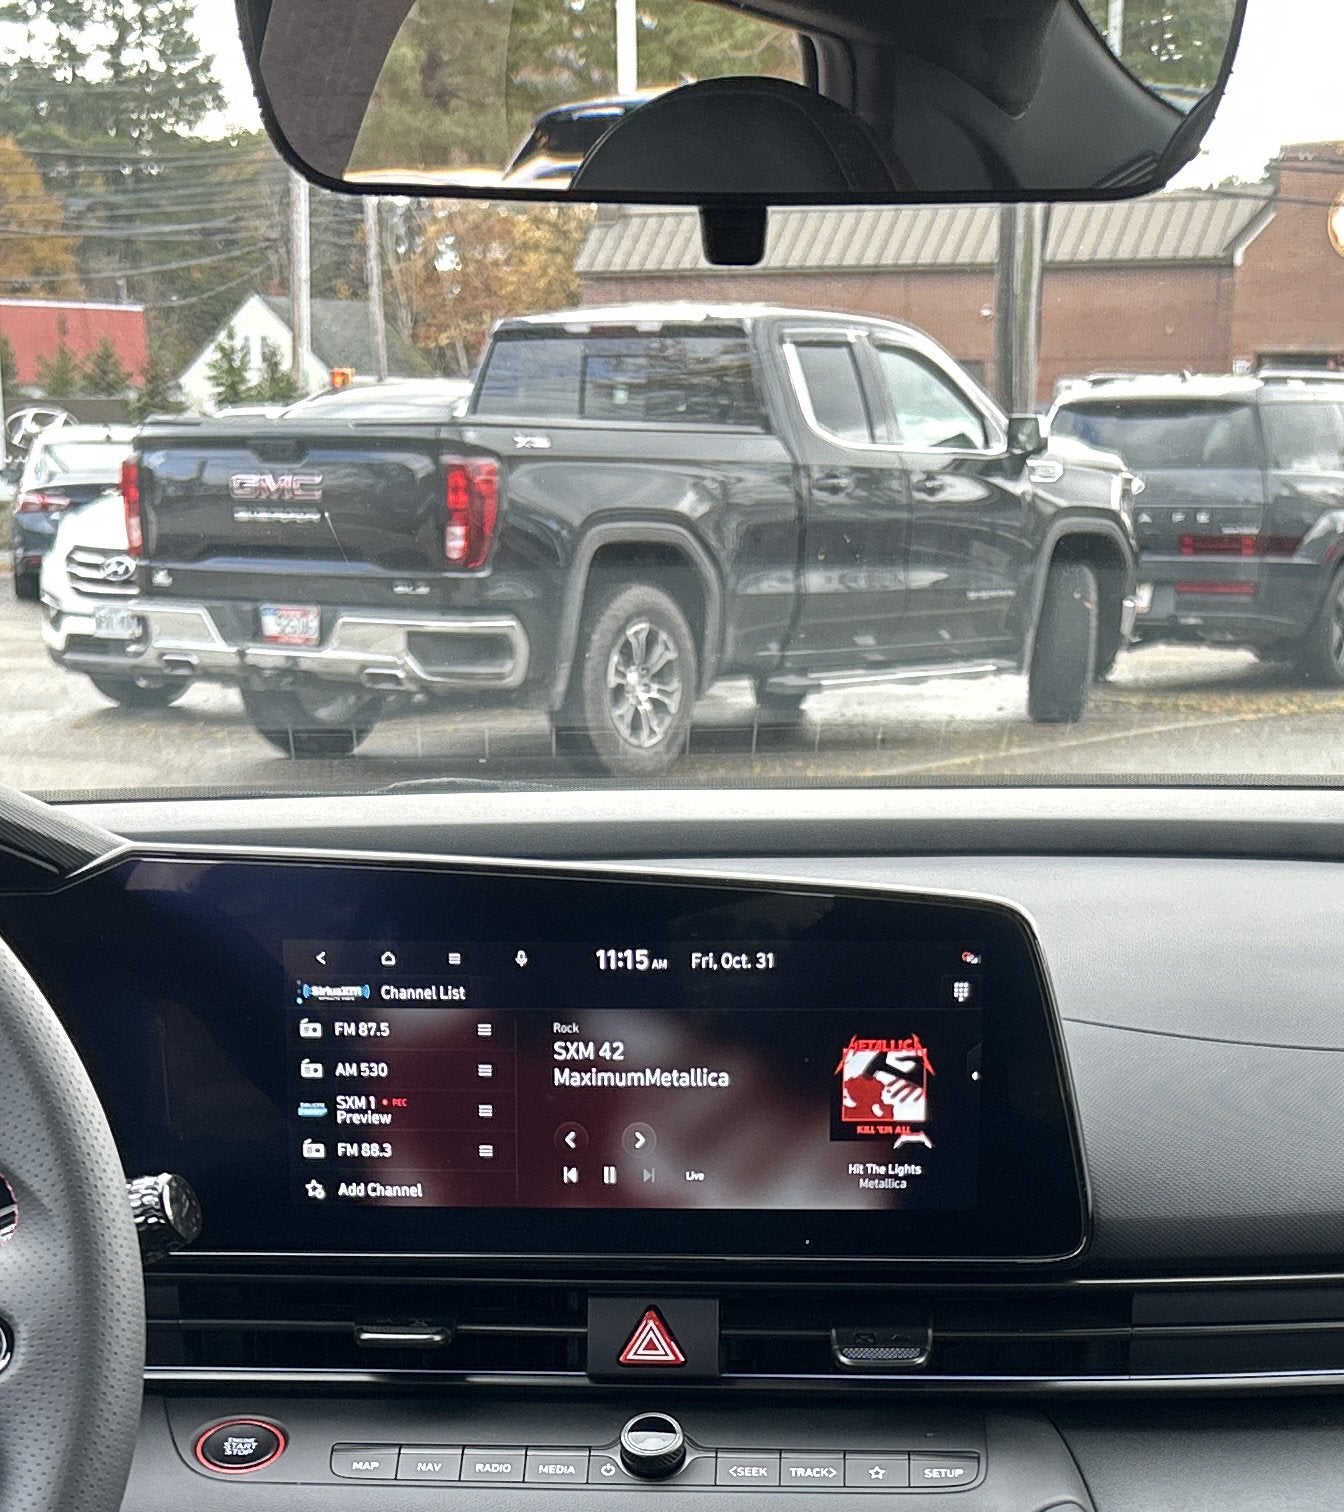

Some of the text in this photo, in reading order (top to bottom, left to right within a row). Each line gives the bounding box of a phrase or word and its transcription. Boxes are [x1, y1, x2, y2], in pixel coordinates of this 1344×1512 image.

[229, 472, 323, 501] GMC
[594, 949, 668, 971] 11:15 AM
[691, 952, 774, 970] Fri, Oct. 31
[380, 984, 466, 1000] Channel List
[334, 1022, 390, 1037] FM 87.5
[553, 1022, 580, 1035] Rock
[553, 1041, 624, 1060] SXM 42
[335, 1062, 388, 1077] AM 530
[553, 1068, 730, 1088] MaximumMetallica
[336, 1095, 366, 1110] SXM
[368, 1095, 376, 1110] 1
[336, 1110, 392, 1125] Preview
[337, 1142, 393, 1158] FM 88.3
[685, 1171, 705, 1181] Live
[848, 1163, 922, 1176] Hit The Lights
[338, 1182, 423, 1198] Add Channel
[859, 1177, 907, 1190] Metallica
[352, 1460, 380, 1472] MAP
[416, 1461, 443, 1473] NAV
[475, 1462, 512, 1474] RADIO
[538, 1464, 576, 1475] MEDIA
[923, 1467, 965, 1479] SETUP
